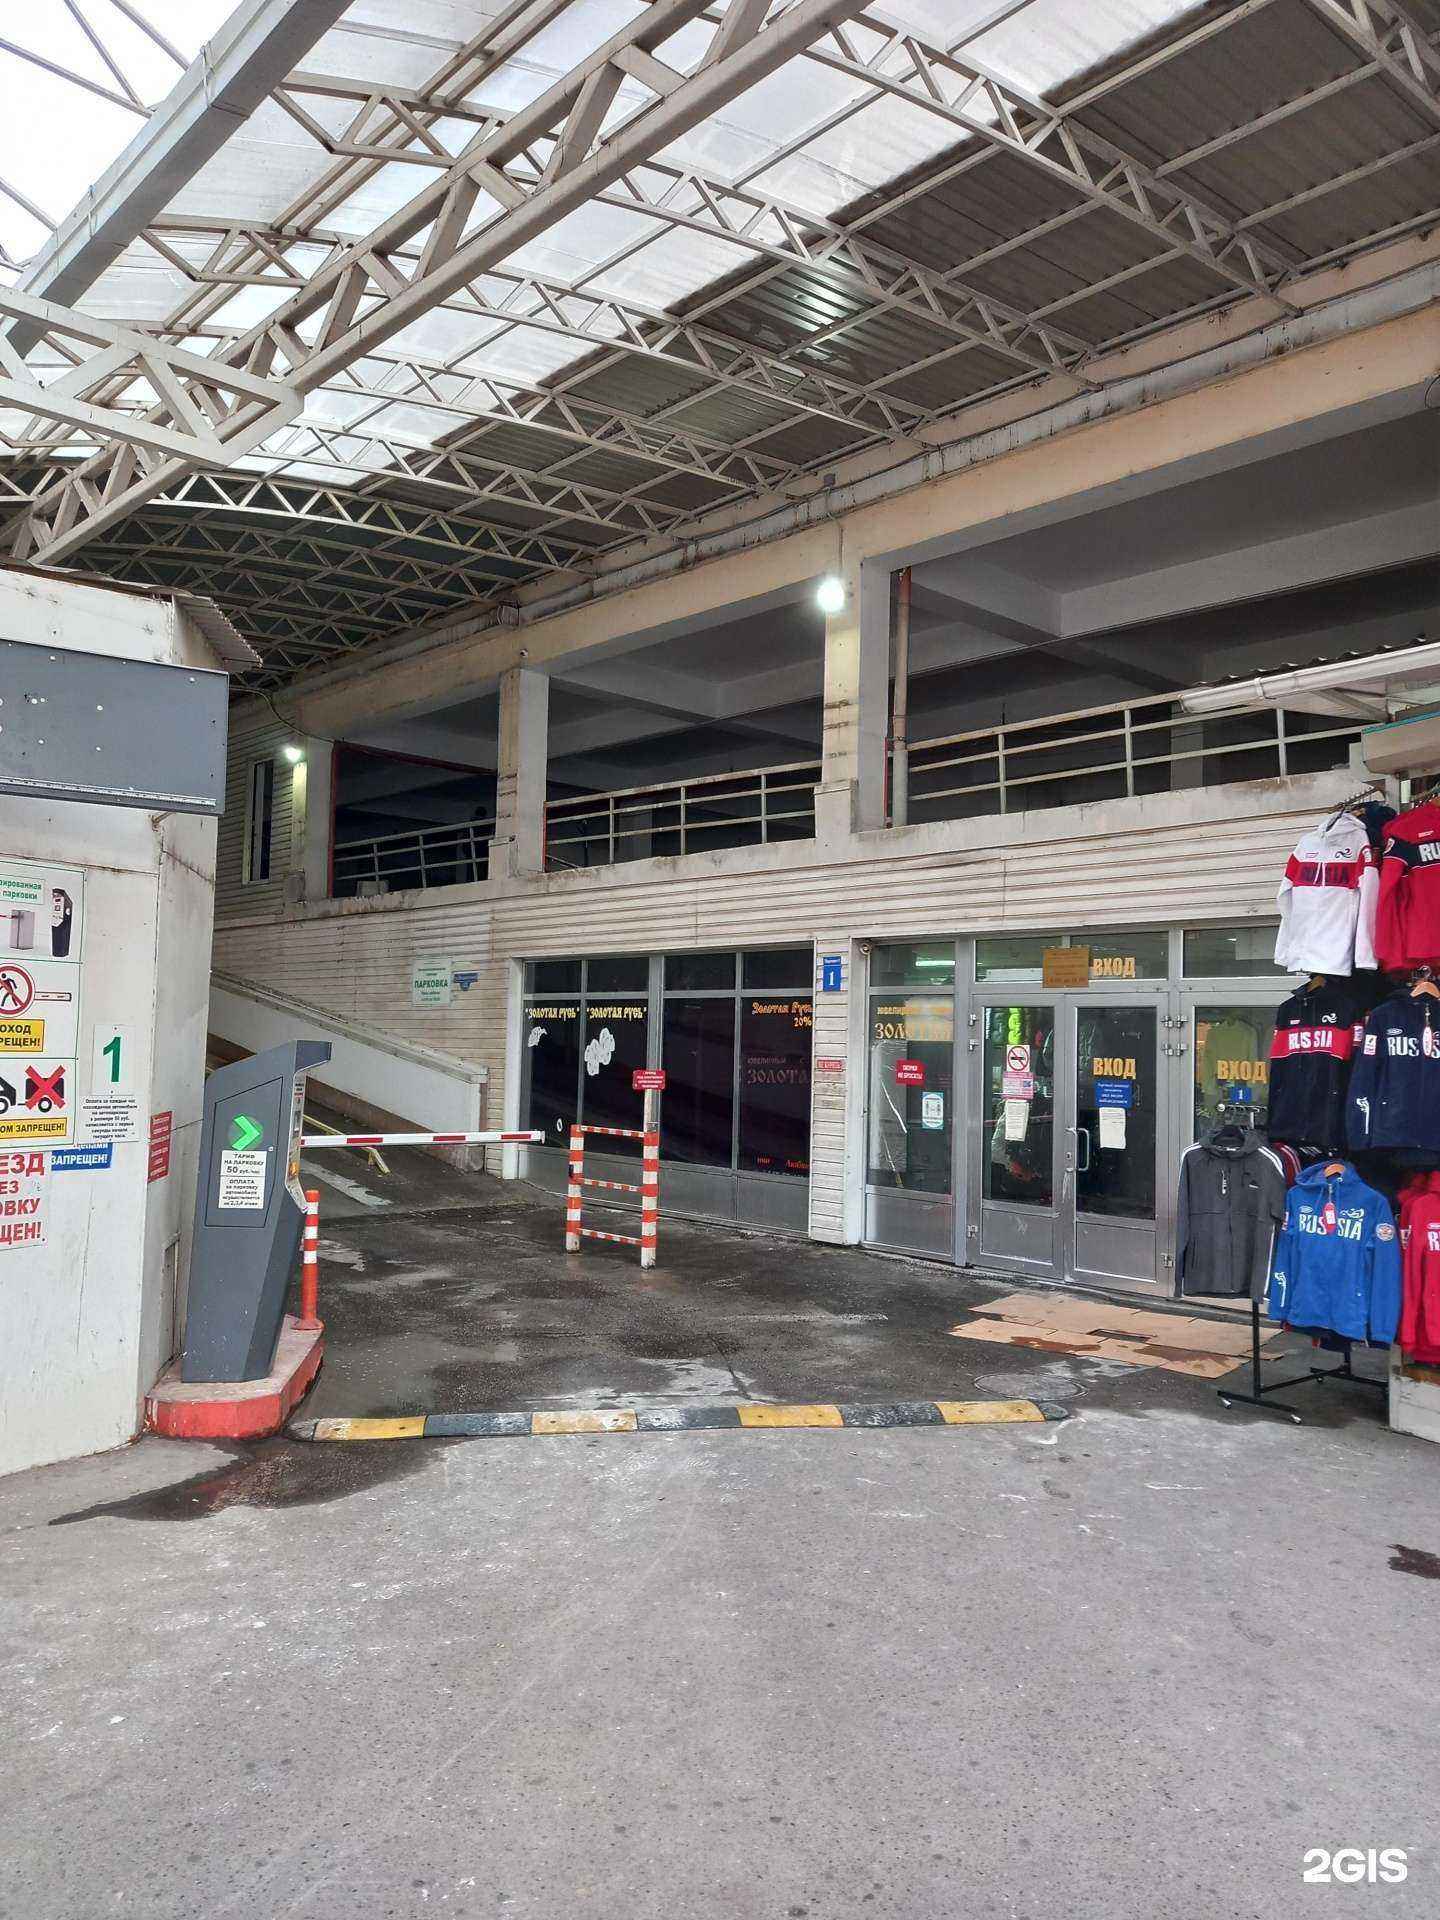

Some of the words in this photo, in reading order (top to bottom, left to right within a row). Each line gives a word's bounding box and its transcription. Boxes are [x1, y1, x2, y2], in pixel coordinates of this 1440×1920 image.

[1093, 957, 1136, 978] ВХОД
[414, 980, 448, 988] ПАРКОВКА
[829, 971, 835, 985] 1
[103, 1036, 121, 1082] 1
[1093, 1057, 1136, 1079] ВХОД
[1217, 1060, 1267, 1084] ВХОД
[16, 1123, 64, 1132] ЗАПРЕЩЕН!
[50, 1154, 108, 1166] ЗАПРЕЩЕН!
